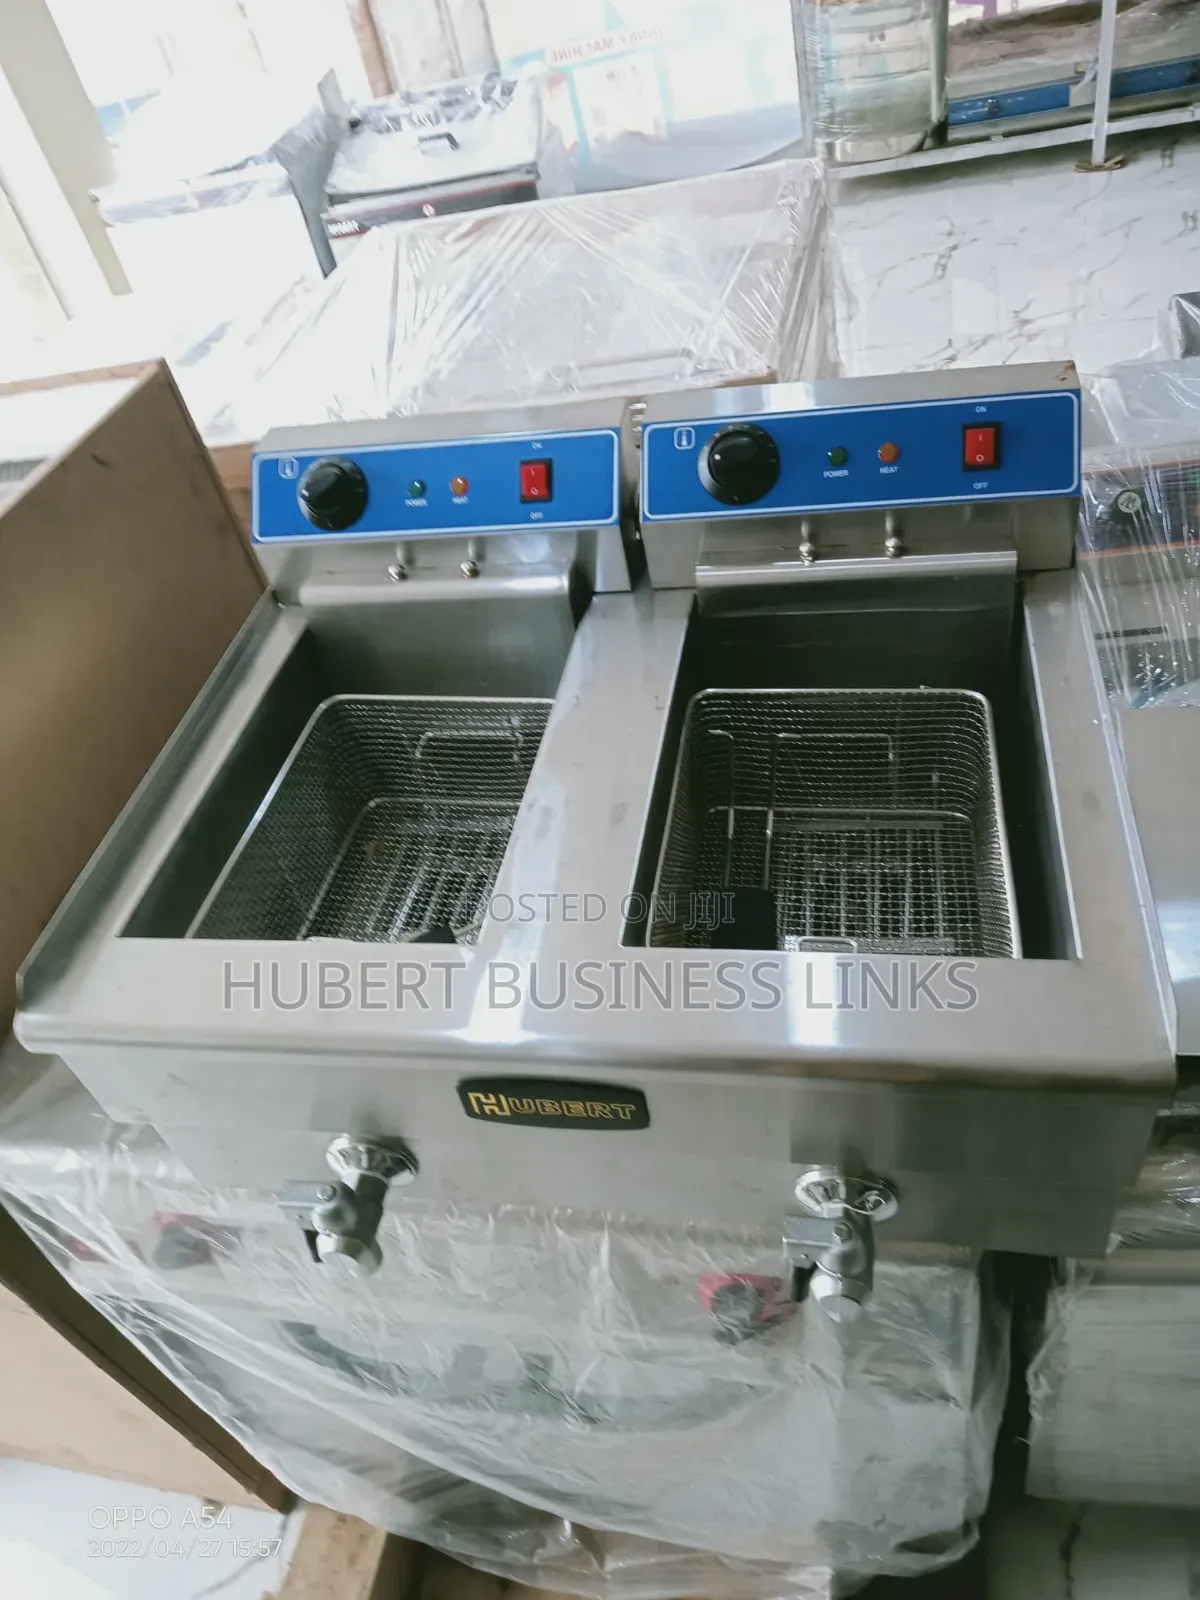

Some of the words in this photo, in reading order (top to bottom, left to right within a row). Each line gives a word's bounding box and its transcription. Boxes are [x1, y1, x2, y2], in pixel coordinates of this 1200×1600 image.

[975, 405, 987, 413] ON
[823, 469, 849, 478] POWER
[879, 466, 898, 474] HEAT
[973, 481, 988, 490] OFF
[467, 1091, 636, 1121] HUBERT
